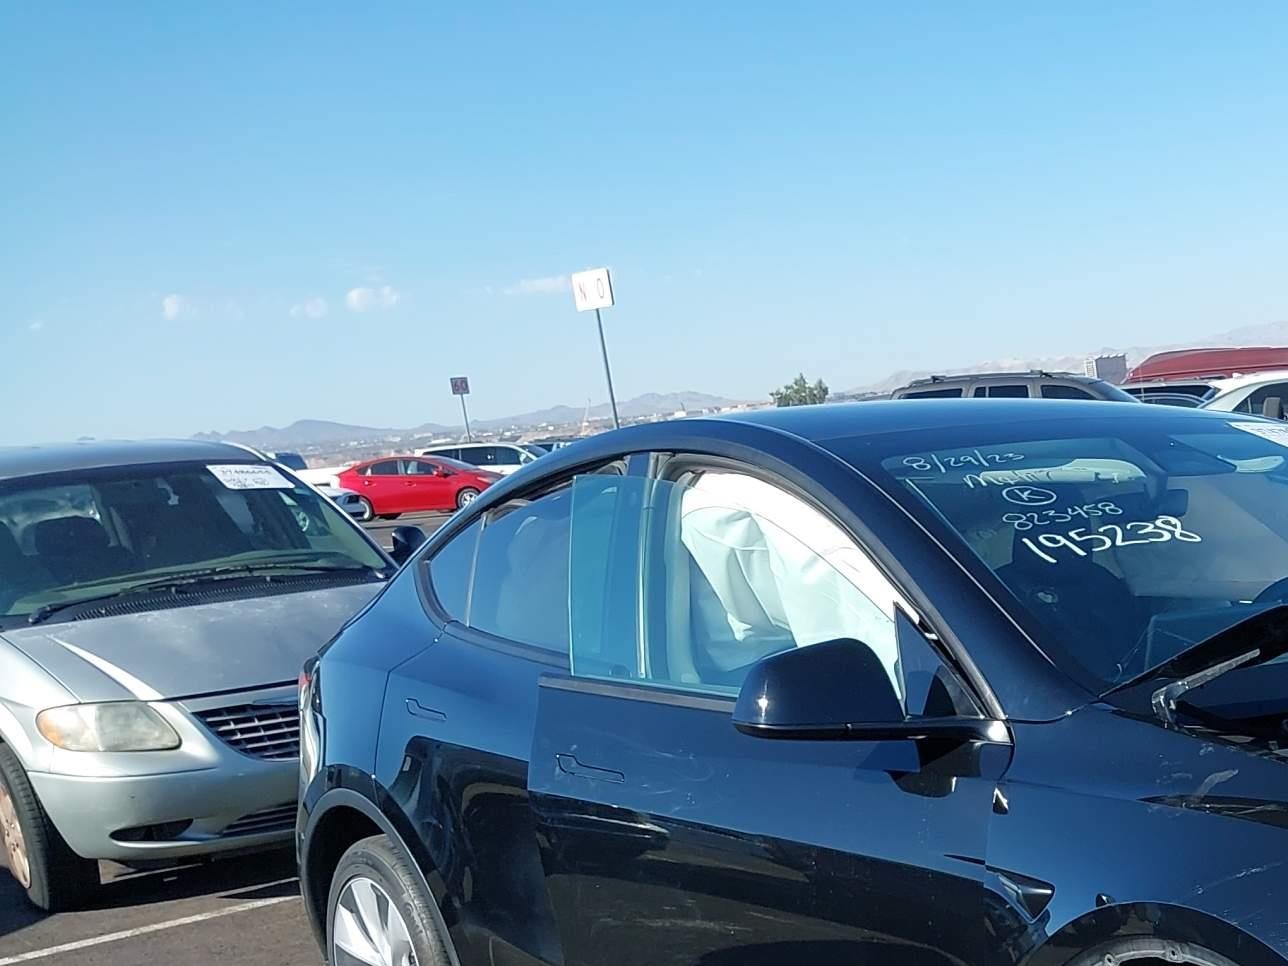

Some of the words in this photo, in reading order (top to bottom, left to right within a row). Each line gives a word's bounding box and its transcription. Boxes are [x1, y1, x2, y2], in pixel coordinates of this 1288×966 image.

[902, 449, 1025, 474] 8/29/23
[1002, 502, 1123, 530] 823458
[1022, 515, 1202, 564] 195238
